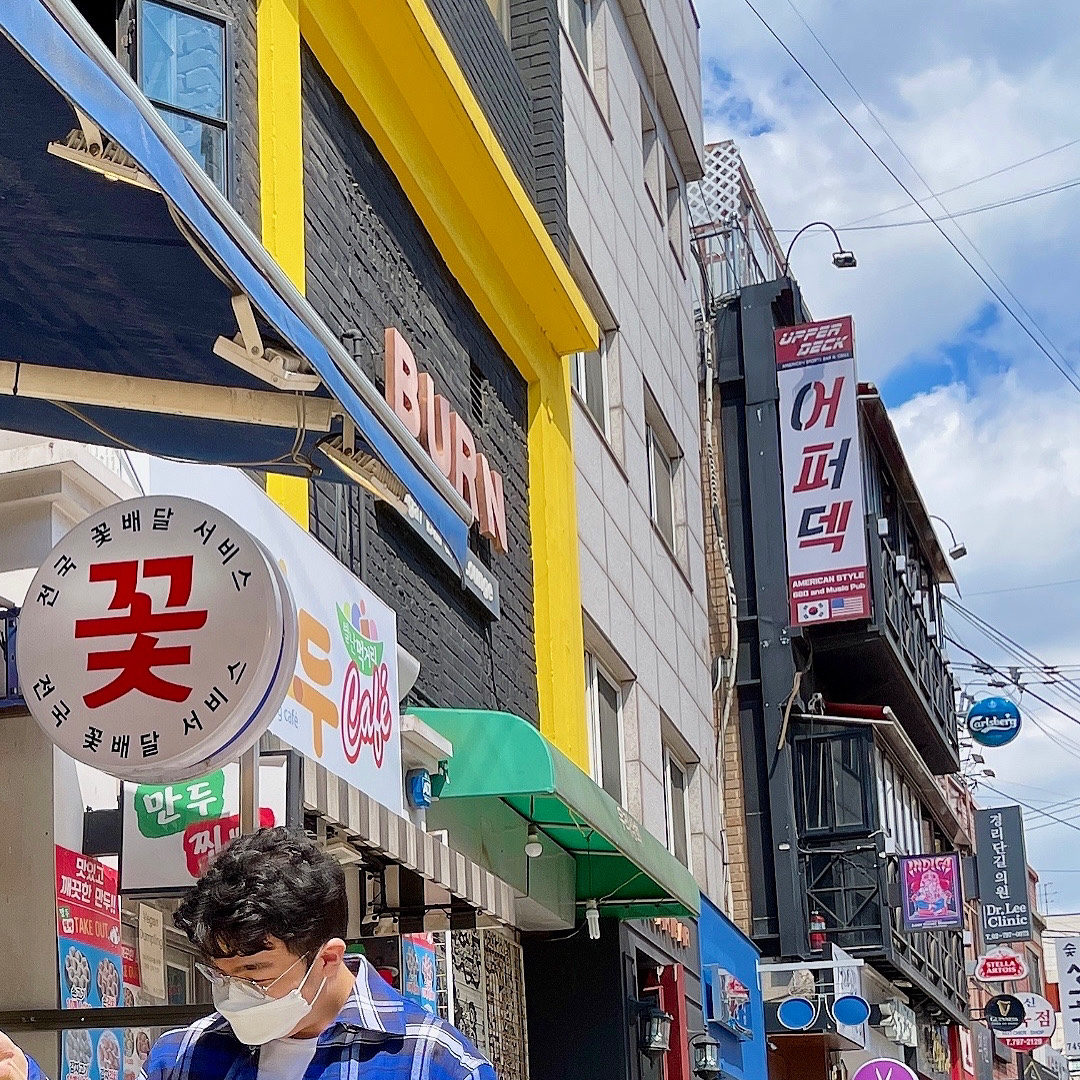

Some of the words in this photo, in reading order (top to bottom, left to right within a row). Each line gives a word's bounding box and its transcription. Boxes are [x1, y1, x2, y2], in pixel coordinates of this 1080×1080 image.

[779, 322, 843, 346] UPPER
[796, 335, 849, 357] DECK
[384, 326, 508, 554] BURN
[789, 375, 854, 554] 어퍼덱
[35, 554, 78, 609] 전국
[90, 507, 175, 546] 꽃배달
[193, 518, 254, 593] 서비스
[792, 576, 835, 589] AMERICAN
[836, 571, 865, 582] STYLE
[810, 588, 825, 597] and
[850, 582, 866, 591] Pub
[74, 554, 209, 710] 꽃
[31, 672, 71, 730] 전국
[82, 730, 161, 759] 꽃배달
[181, 659, 248, 738] 서비스
[969, 712, 1018, 734] Carlsberg
[142, 781, 218, 825] 만두
[76, 857, 105, 886] 맛있고
[60, 875, 93, 904] 깨끗한
[94, 887, 117, 915] 만두!!
[74, 916, 94, 936] TAKE
[94, 921, 110, 938] OUT
[987, 914, 1029, 928] Clinic
[985, 960, 1017, 968] STELLA
[985, 966, 1017, 974] ARTOIS
